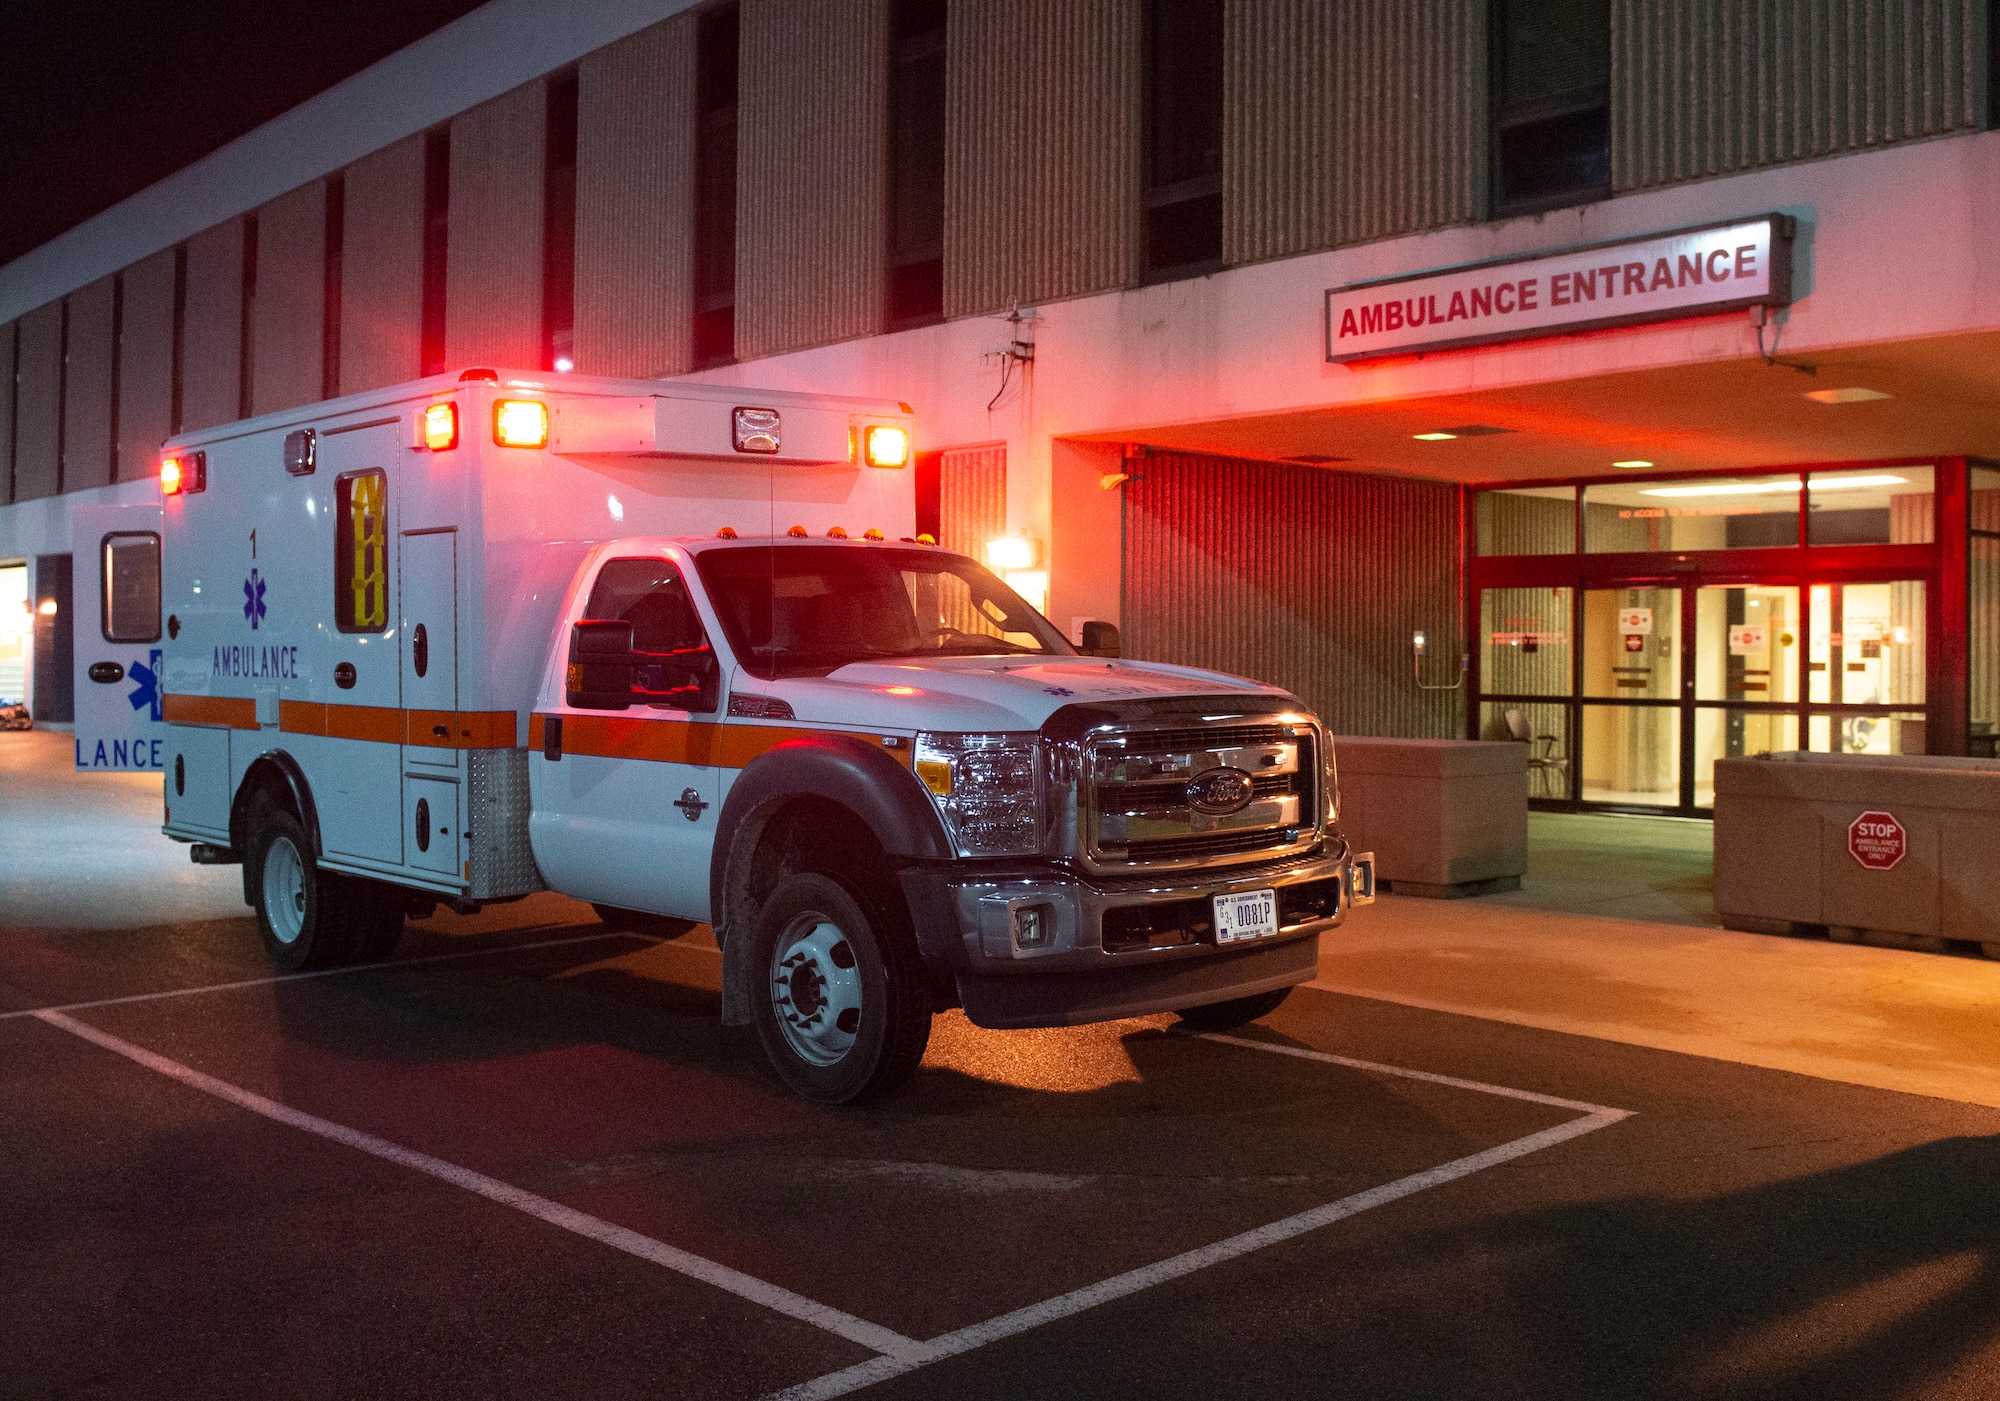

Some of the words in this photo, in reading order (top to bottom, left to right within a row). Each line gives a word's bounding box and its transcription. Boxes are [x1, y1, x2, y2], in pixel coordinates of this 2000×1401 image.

[1338, 279, 1538, 338] AMBULANCE
[1550, 244, 1758, 306] ENTRANCE
[250, 528, 256, 559] 1
[213, 646, 298, 679] AMBULANCE
[76, 739, 163, 768] LANCE
[1207, 774, 1242, 802] Ford
[1855, 838, 1900, 847] AMBULANCE
[1858, 823, 1897, 837] STOP
[1858, 845, 1897, 854] ENTRANCE
[1868, 852, 1887, 860] ONLY
[1237, 902, 1271, 927] 0081P
